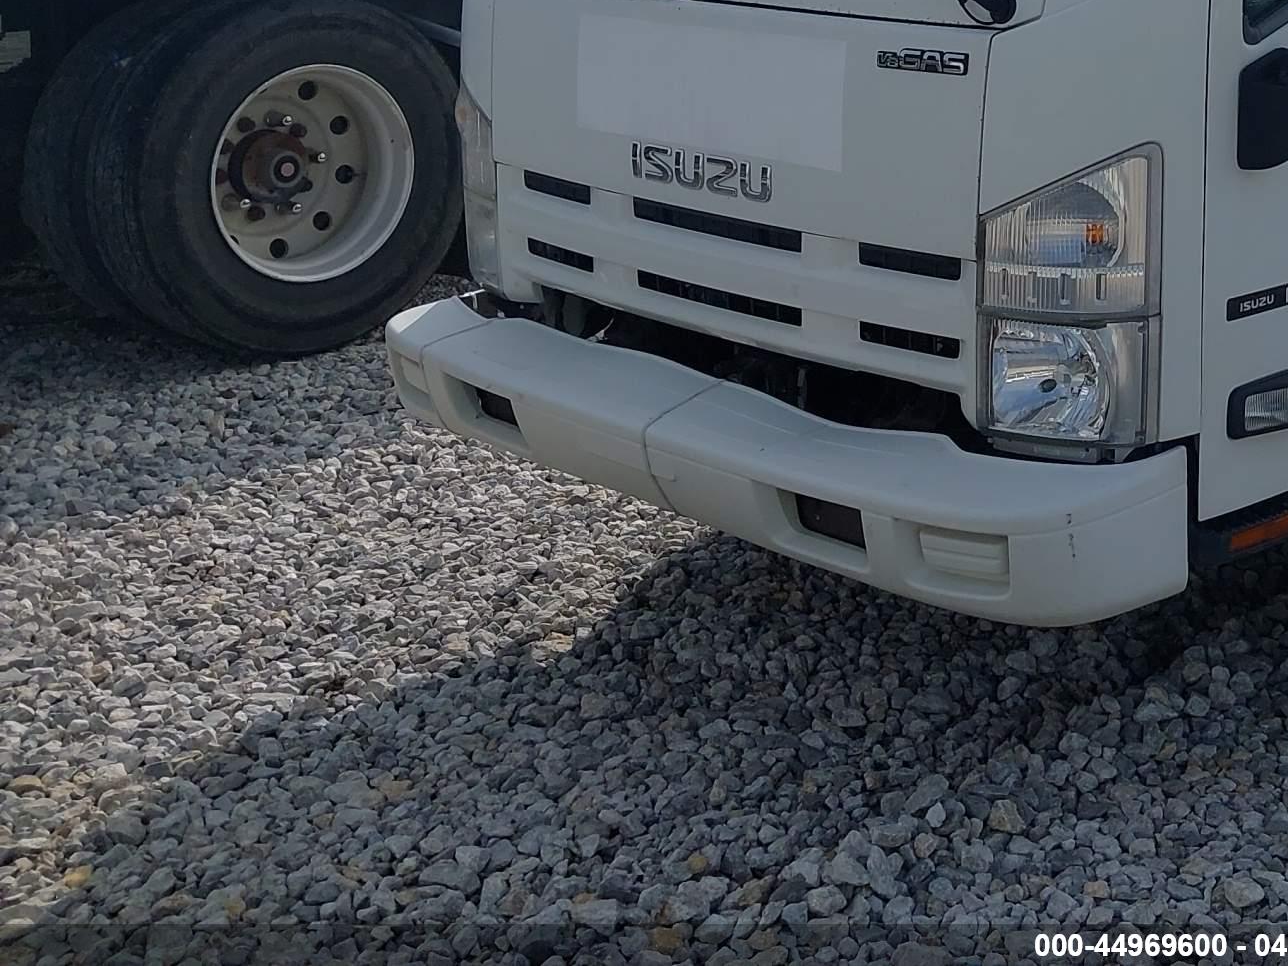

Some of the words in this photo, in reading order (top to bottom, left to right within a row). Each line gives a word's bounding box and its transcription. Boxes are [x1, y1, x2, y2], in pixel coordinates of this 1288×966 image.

[900, 49, 966, 75] GAS
[631, 140, 773, 203] ISUZU
[1239, 293, 1275, 313] ISUZU
